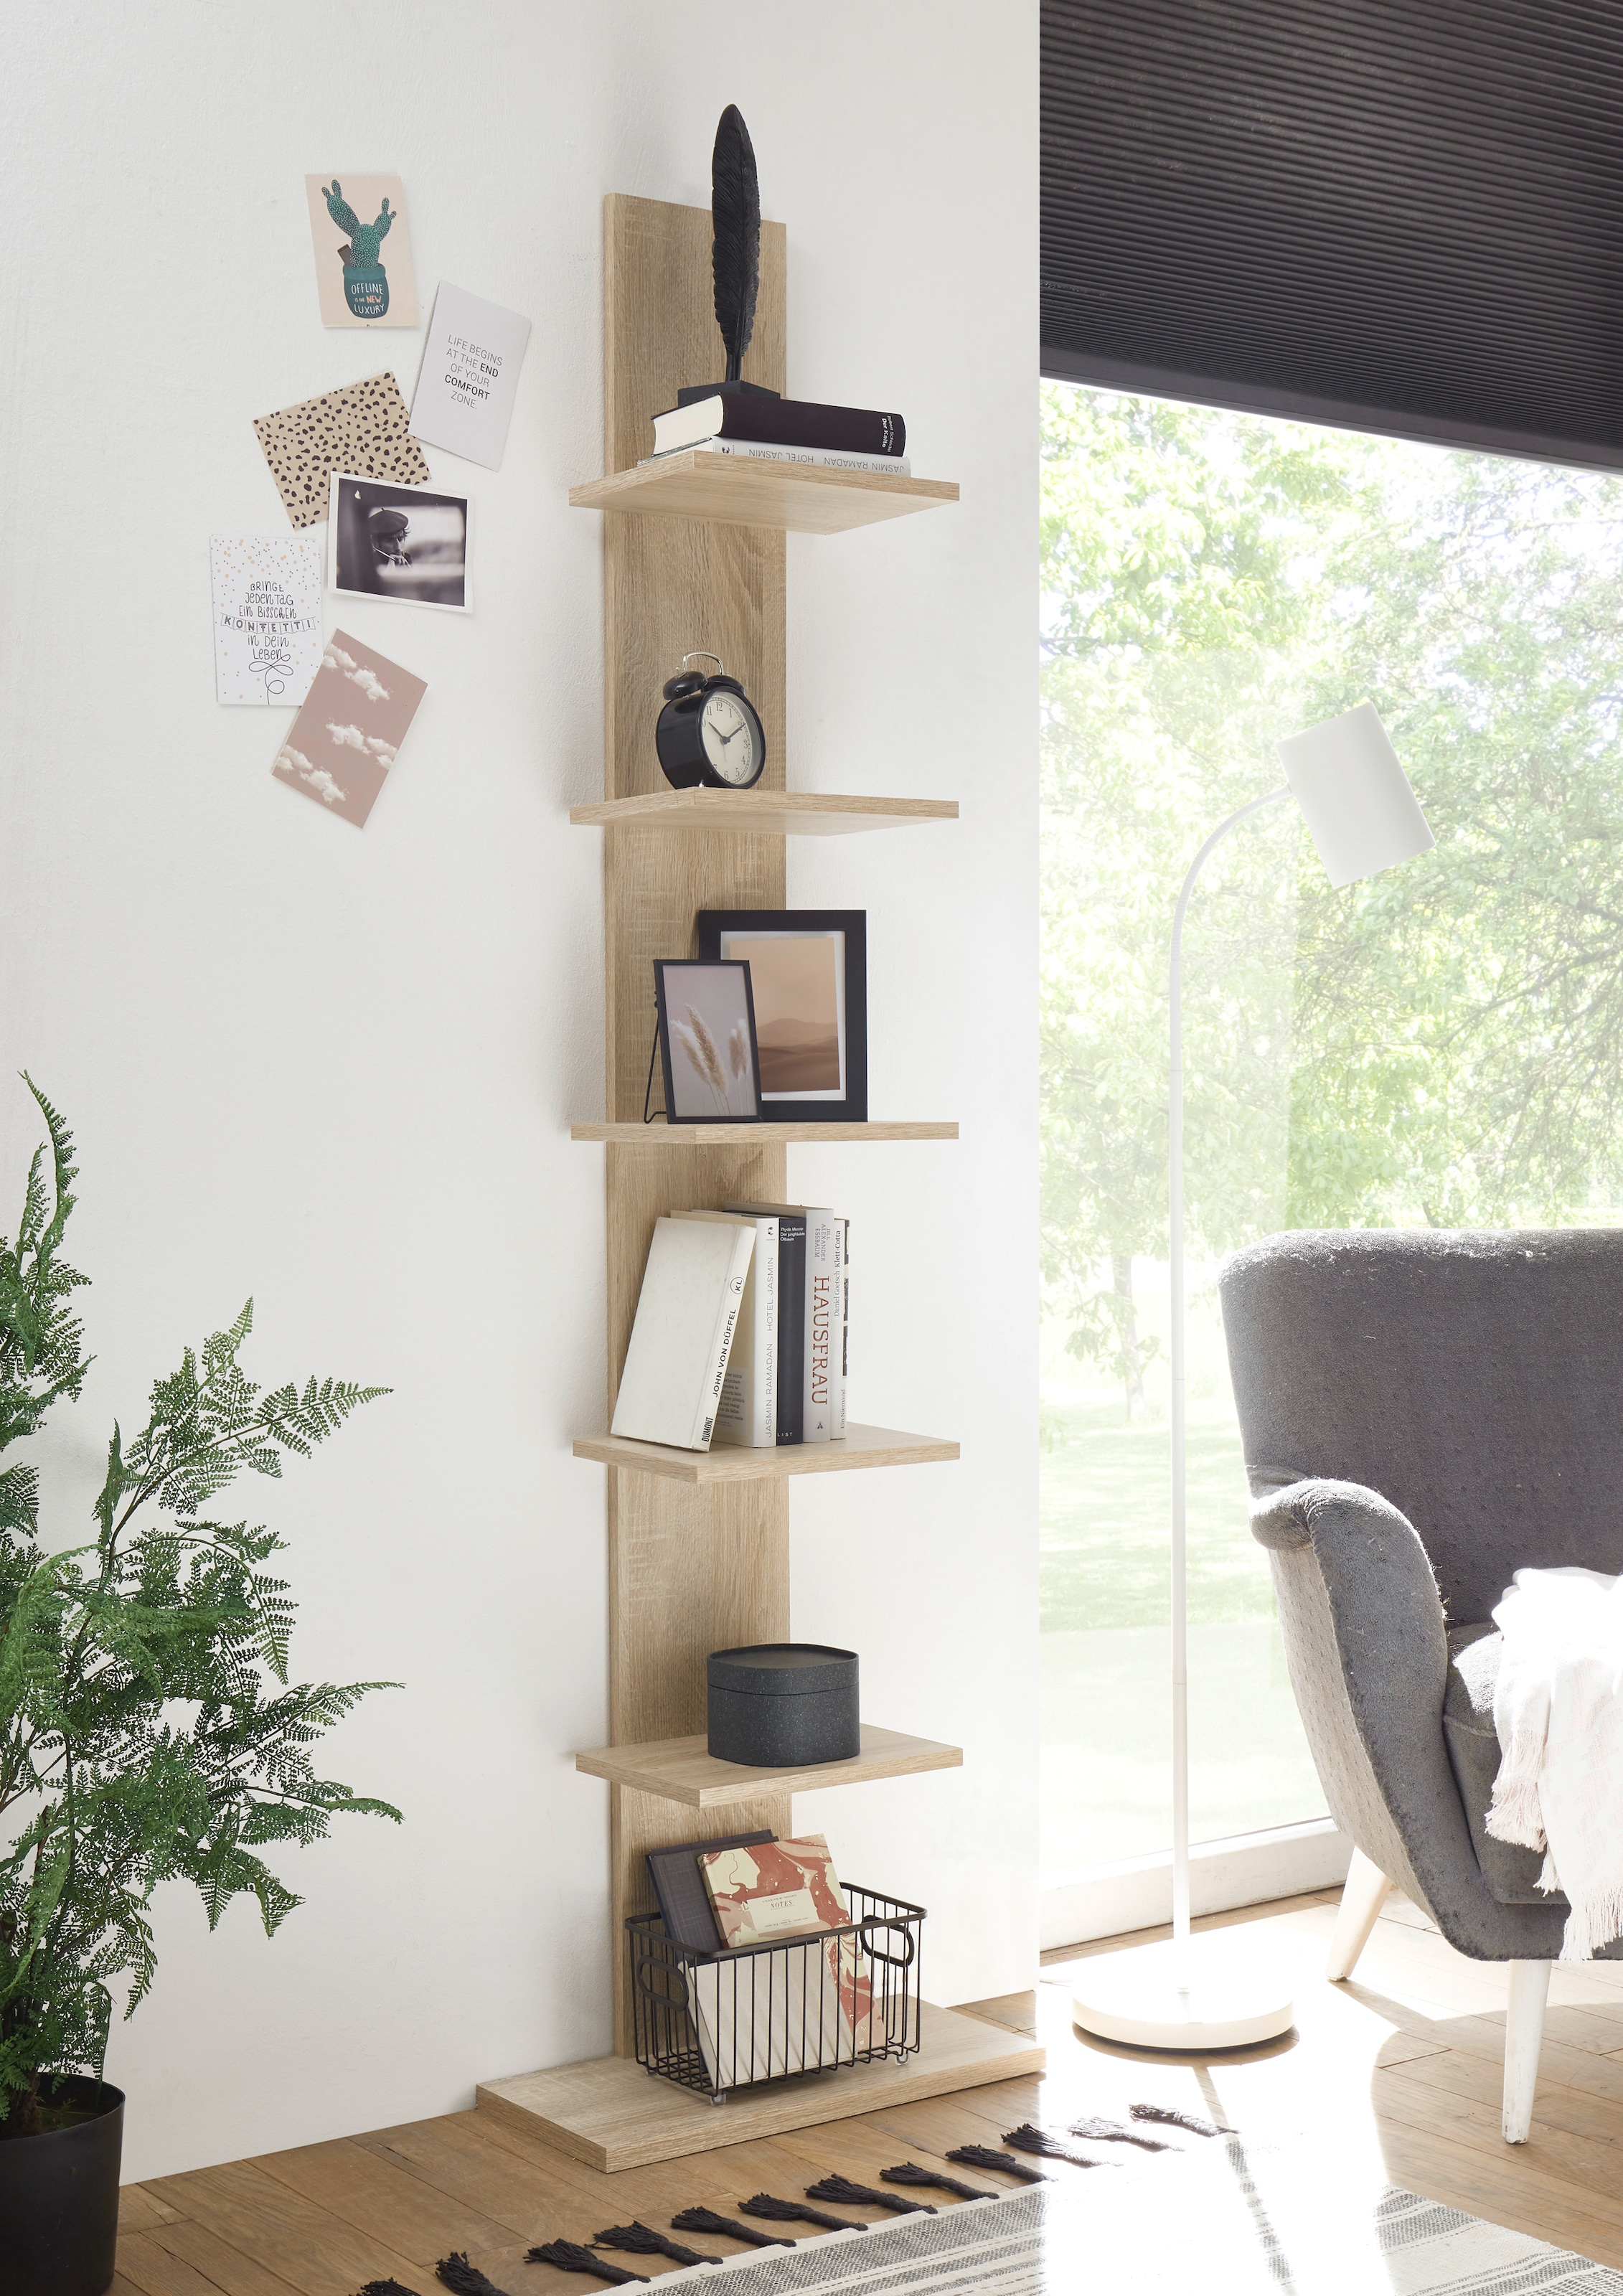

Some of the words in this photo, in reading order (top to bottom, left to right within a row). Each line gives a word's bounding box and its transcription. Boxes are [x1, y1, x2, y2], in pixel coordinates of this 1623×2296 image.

[351, 283, 383, 295] OFFLINE
[366, 295, 382, 304] NEW
[354, 304, 385, 314] LUXURY
[448, 334, 468, 350] LIFE
[469, 344, 503, 366] BEGINS
[446, 348, 459, 359] AT
[461, 353, 479, 369] THE
[480, 363, 499, 377] END
[451, 363, 463, 374] OF
[465, 369, 489, 387] YOUR
[445, 375, 490, 400] COMFORT
[451, 390, 477, 410] ZONE.
[748, 448, 783, 459] JASMIN
[786, 453, 814, 463] HOTEL
[824, 457, 868, 469] RAMADAN
[872, 463, 904, 473] JASMIN
[224, 616, 311, 632] KONFETTI
[248, 635, 259, 646] in
[706, 705, 712, 716] 11
[716, 702, 723, 712] 12
[729, 707, 733, 718] 1
[743, 739, 748, 748] 3
[741, 756, 745, 765] 4
[724, 771, 729, 780] 6
[735, 768, 740, 777] 5
[812, 1276, 829, 1405] HAUSFRAU
[712, 1371, 723, 1398] JOHN
[718, 1347, 728, 1368] VON
[723, 1309, 736, 1345] DÜFFEL
[702, 1416, 713, 1442] DUMONT
[771, 1900, 793, 1909] NOTES
